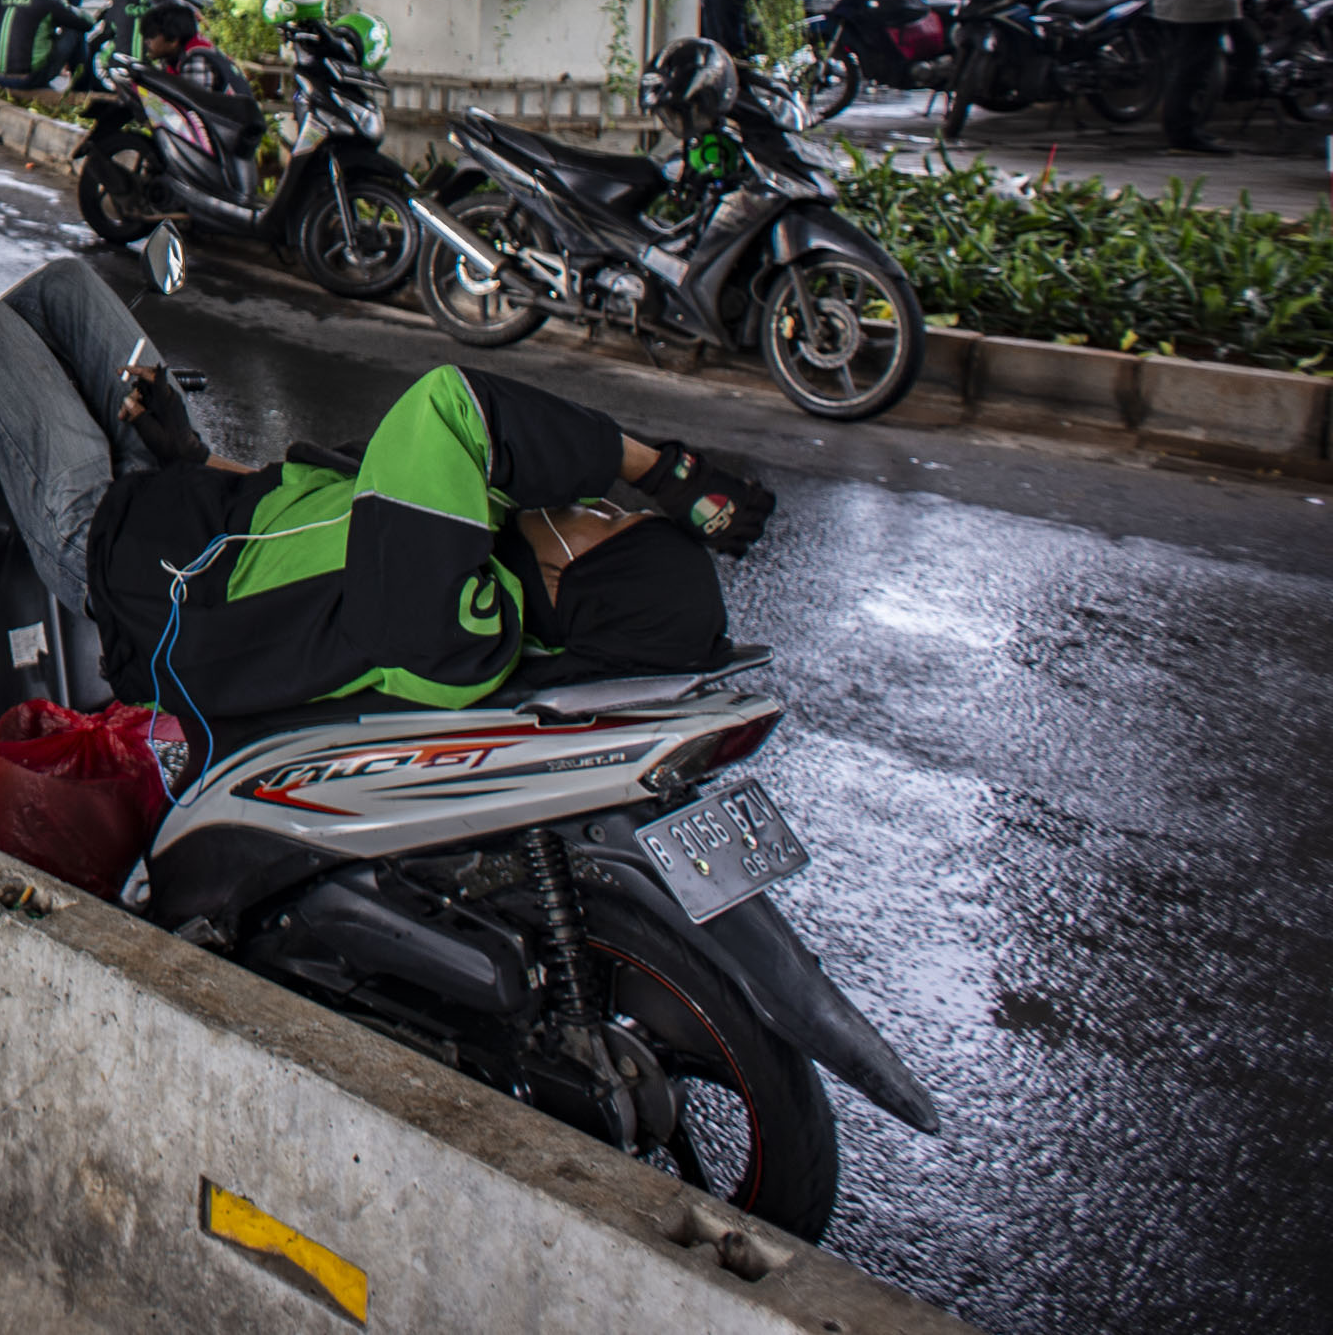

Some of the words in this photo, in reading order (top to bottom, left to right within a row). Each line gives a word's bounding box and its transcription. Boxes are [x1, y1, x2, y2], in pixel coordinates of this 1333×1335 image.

[647, 835, 673, 873] B
[670, 809, 732, 860] 3156
[721, 785, 774, 833] BZV
